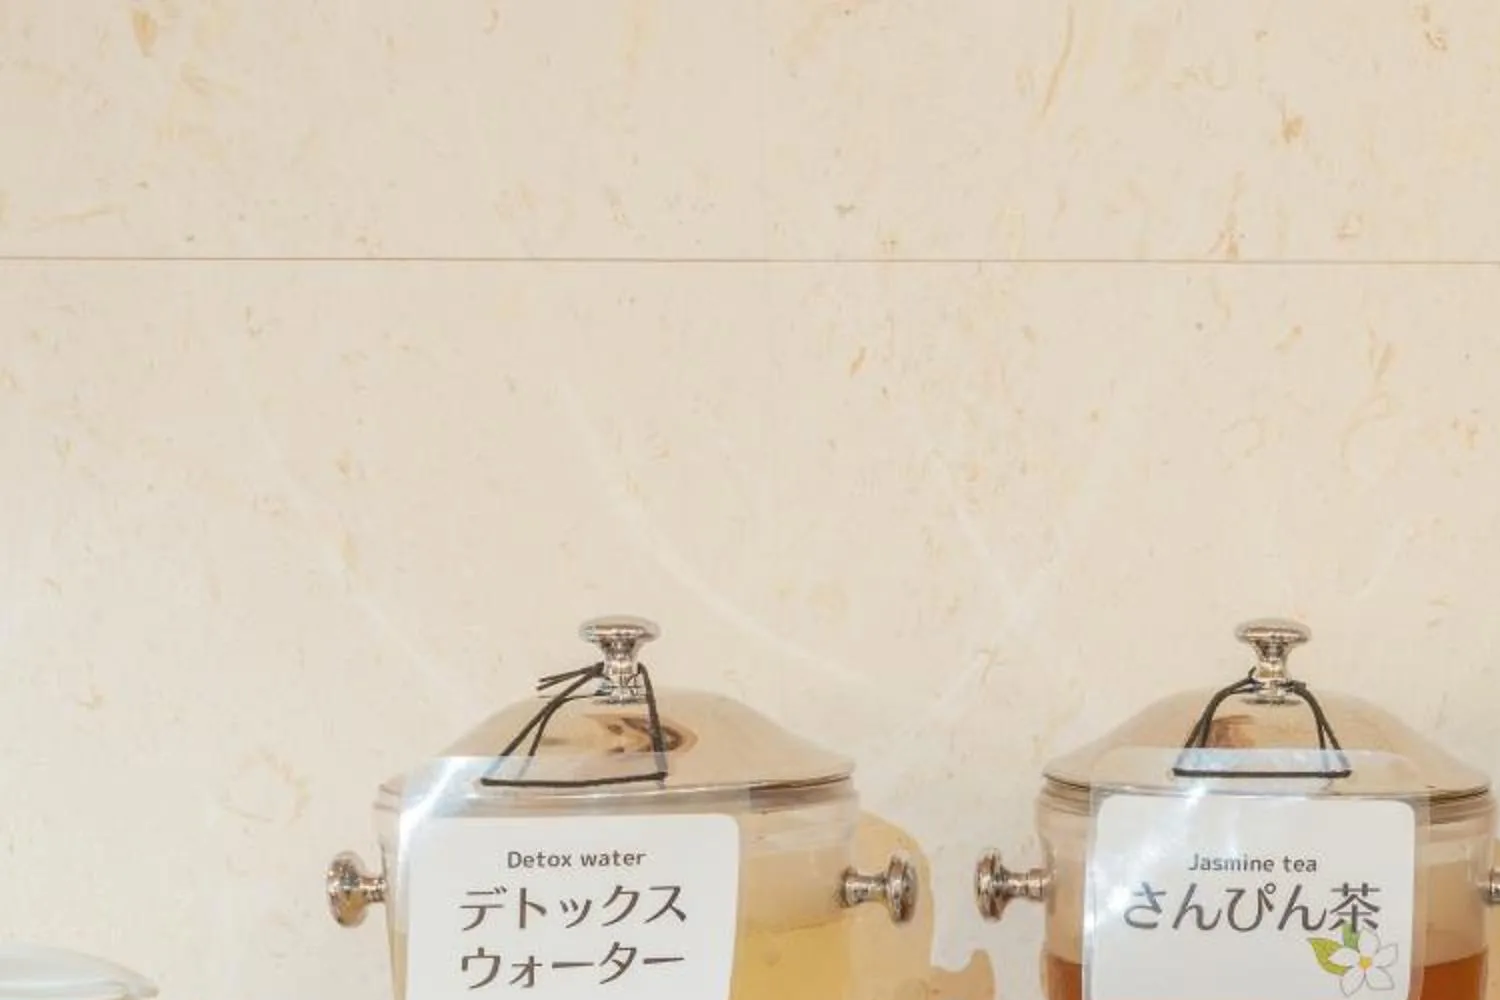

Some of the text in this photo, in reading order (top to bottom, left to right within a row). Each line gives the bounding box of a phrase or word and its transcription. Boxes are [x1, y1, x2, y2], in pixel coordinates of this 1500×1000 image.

[507, 850, 647, 869] Detox water
[1188, 853, 1318, 873] Jasmine tea
[459, 884, 688, 932] デトックス
[1123, 882, 1381, 934] さんぴん茶
[460, 941, 686, 990] ウォーター
